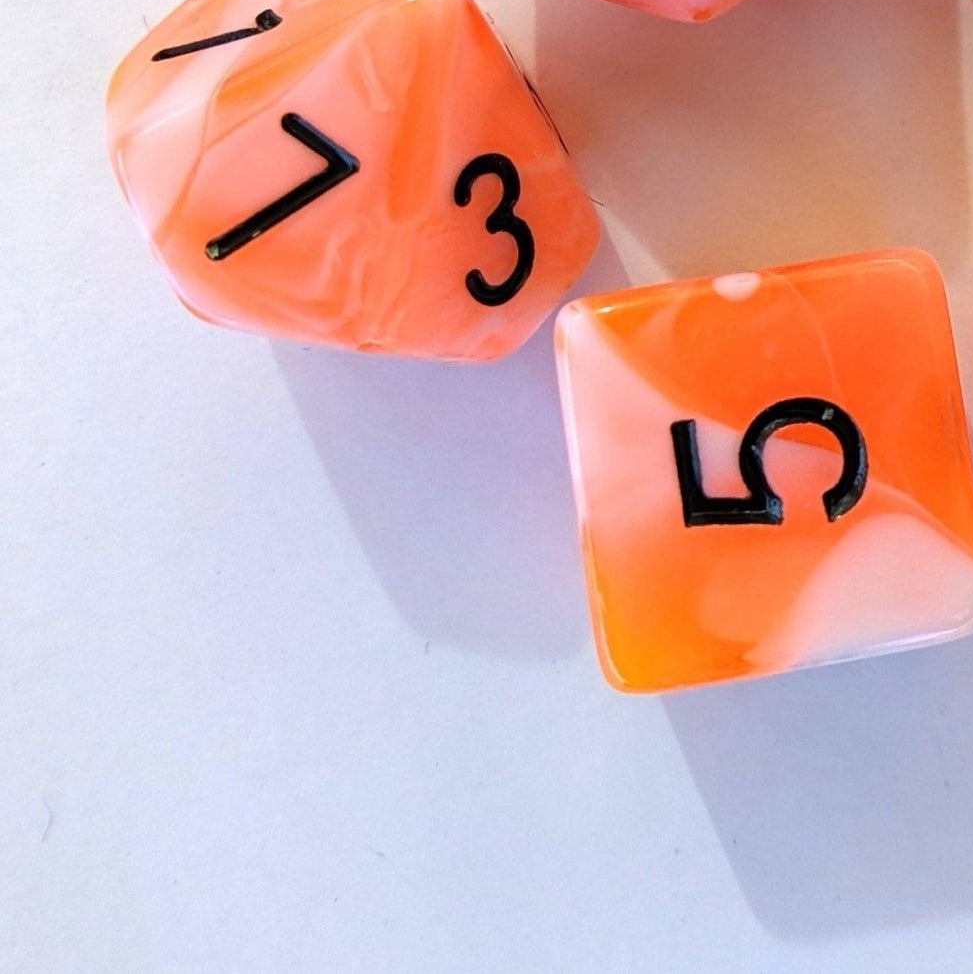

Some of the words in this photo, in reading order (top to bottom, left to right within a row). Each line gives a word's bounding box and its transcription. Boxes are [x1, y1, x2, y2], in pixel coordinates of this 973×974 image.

[150, 7, 284, 63] 1
[204, 111, 361, 262] 7
[452, 152, 536, 308] 3
[669, 396, 870, 529] 5
